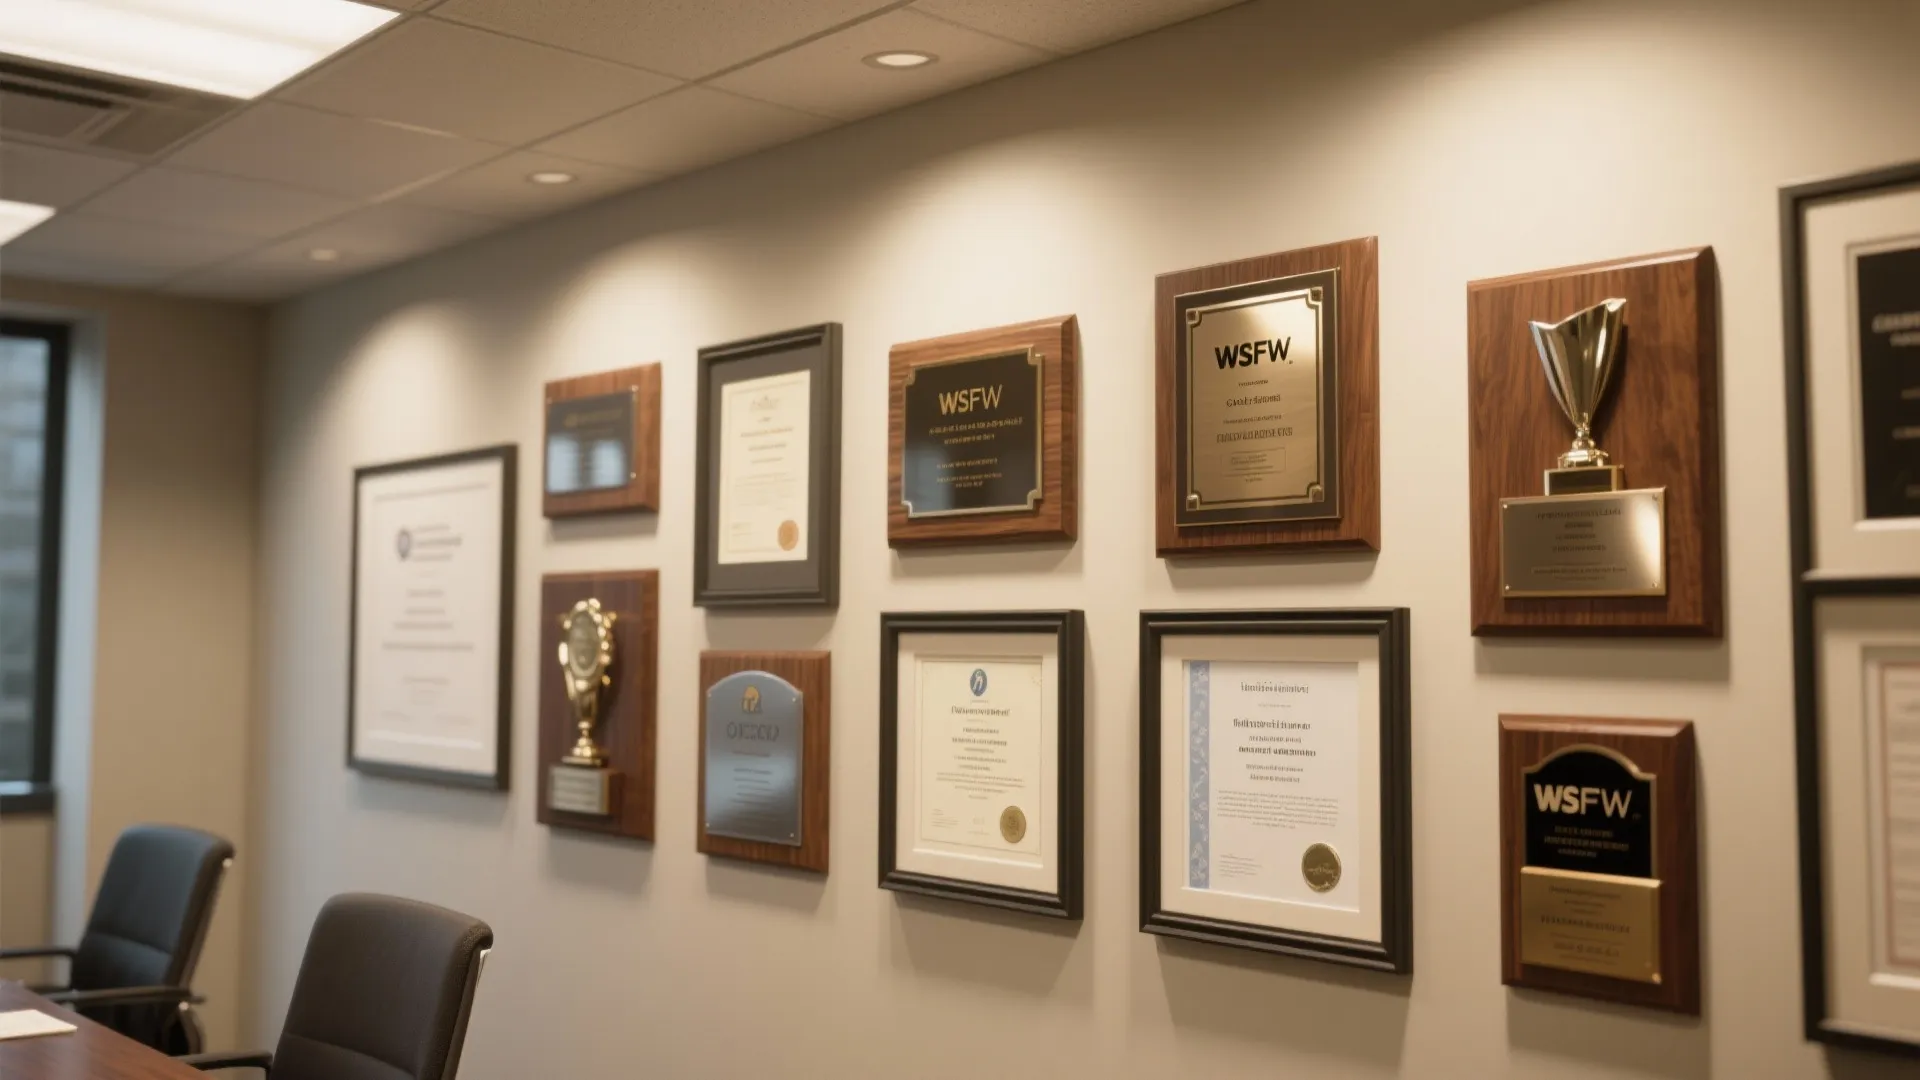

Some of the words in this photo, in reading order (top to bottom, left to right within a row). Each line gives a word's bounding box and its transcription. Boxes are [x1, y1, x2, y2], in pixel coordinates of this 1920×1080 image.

[1214, 337, 1291, 369] WSFW
[939, 385, 1002, 415] WSFW
[1534, 784, 1632, 818] WSFW
